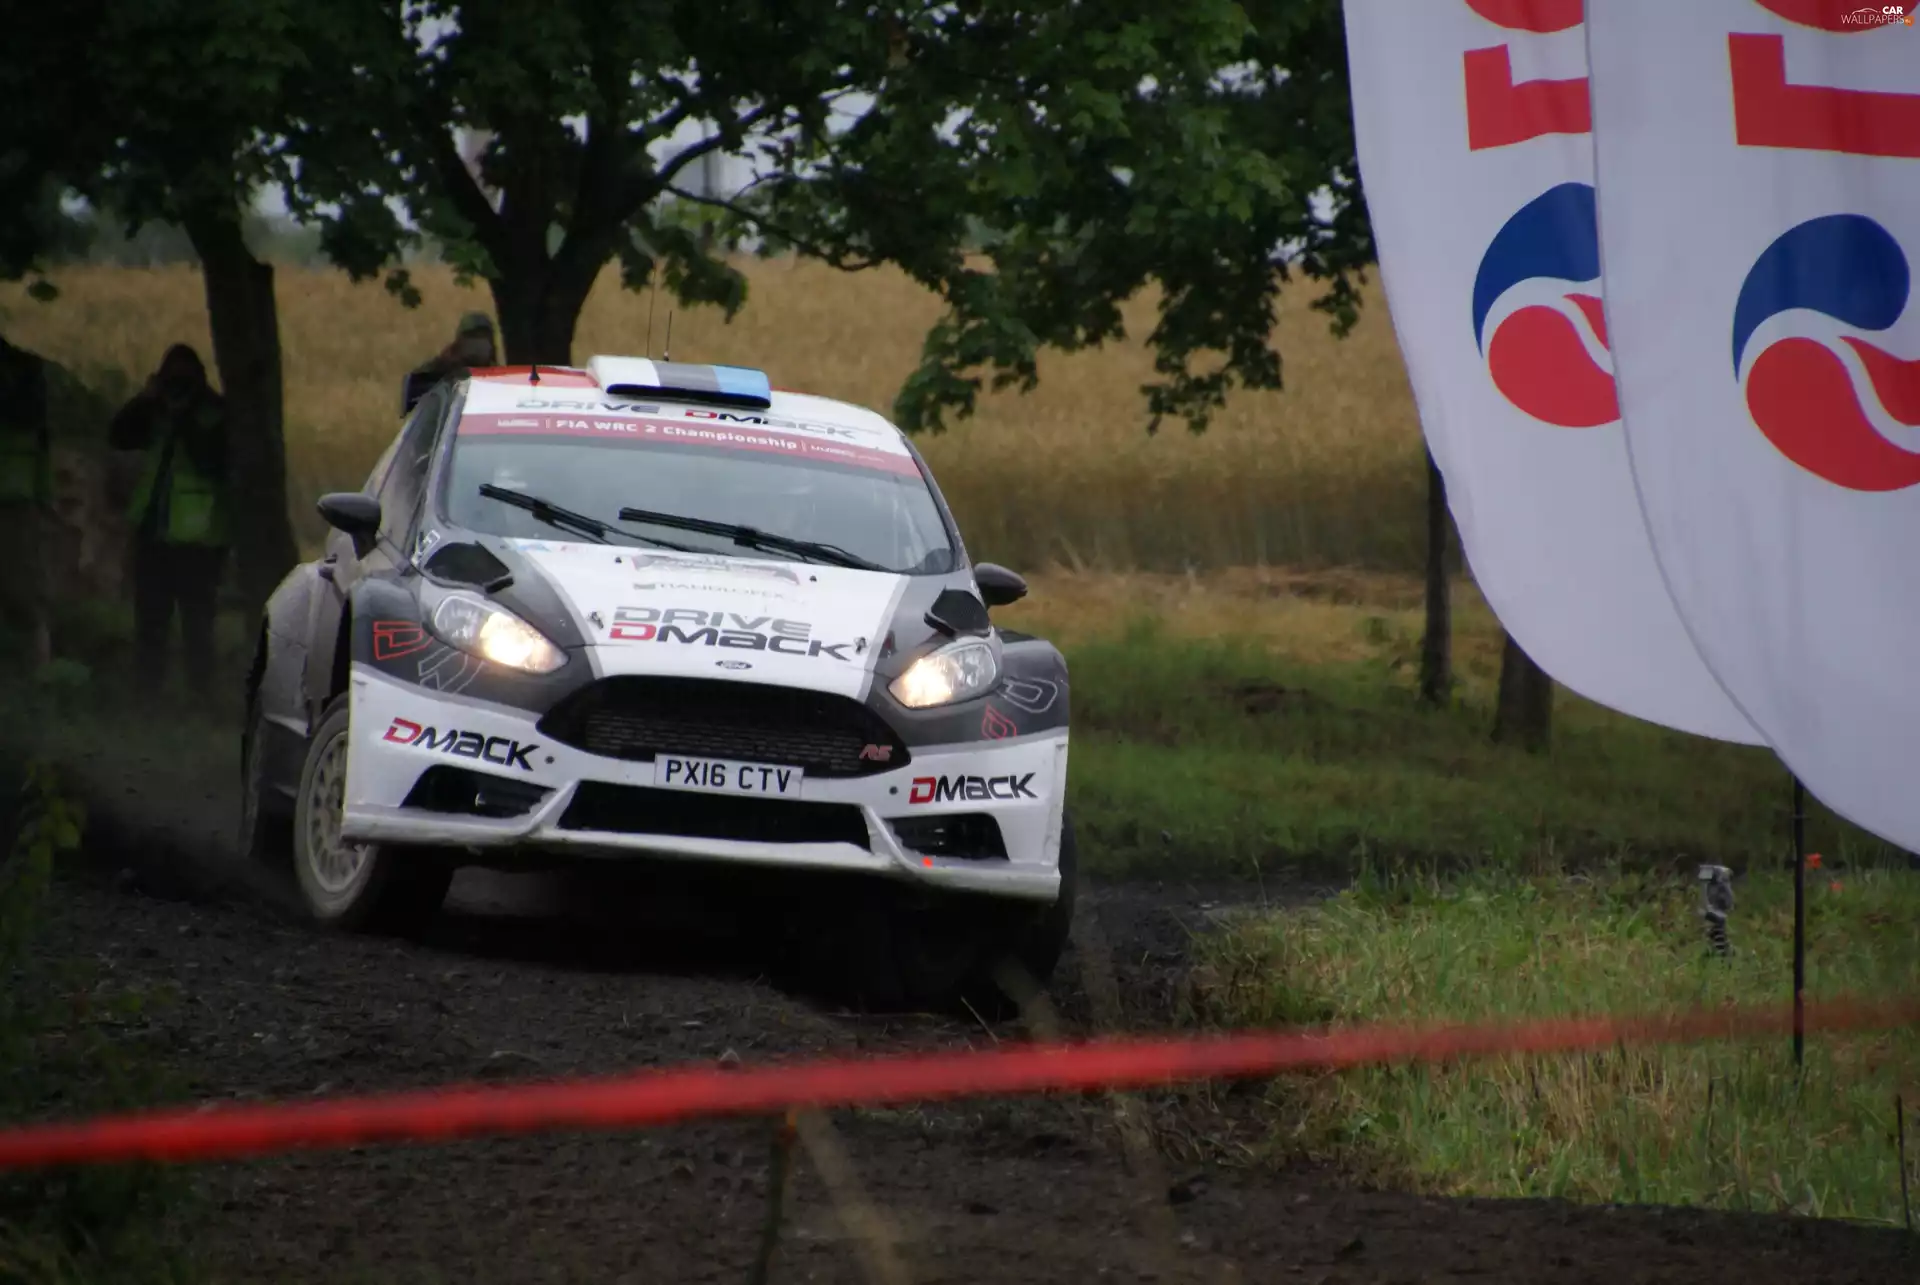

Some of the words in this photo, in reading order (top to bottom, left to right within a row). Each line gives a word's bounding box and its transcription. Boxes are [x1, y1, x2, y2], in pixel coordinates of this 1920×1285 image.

[516, 400, 661, 414] DRIVE
[556, 419, 589, 429] FIA
[594, 421, 638, 432] WRC
[645, 425, 657, 434] 2
[662, 426, 797, 450] Championship
[612, 606, 812, 637] DRIVE
[666, 759, 726, 787] PX16
[738, 766, 792, 793] CTV
